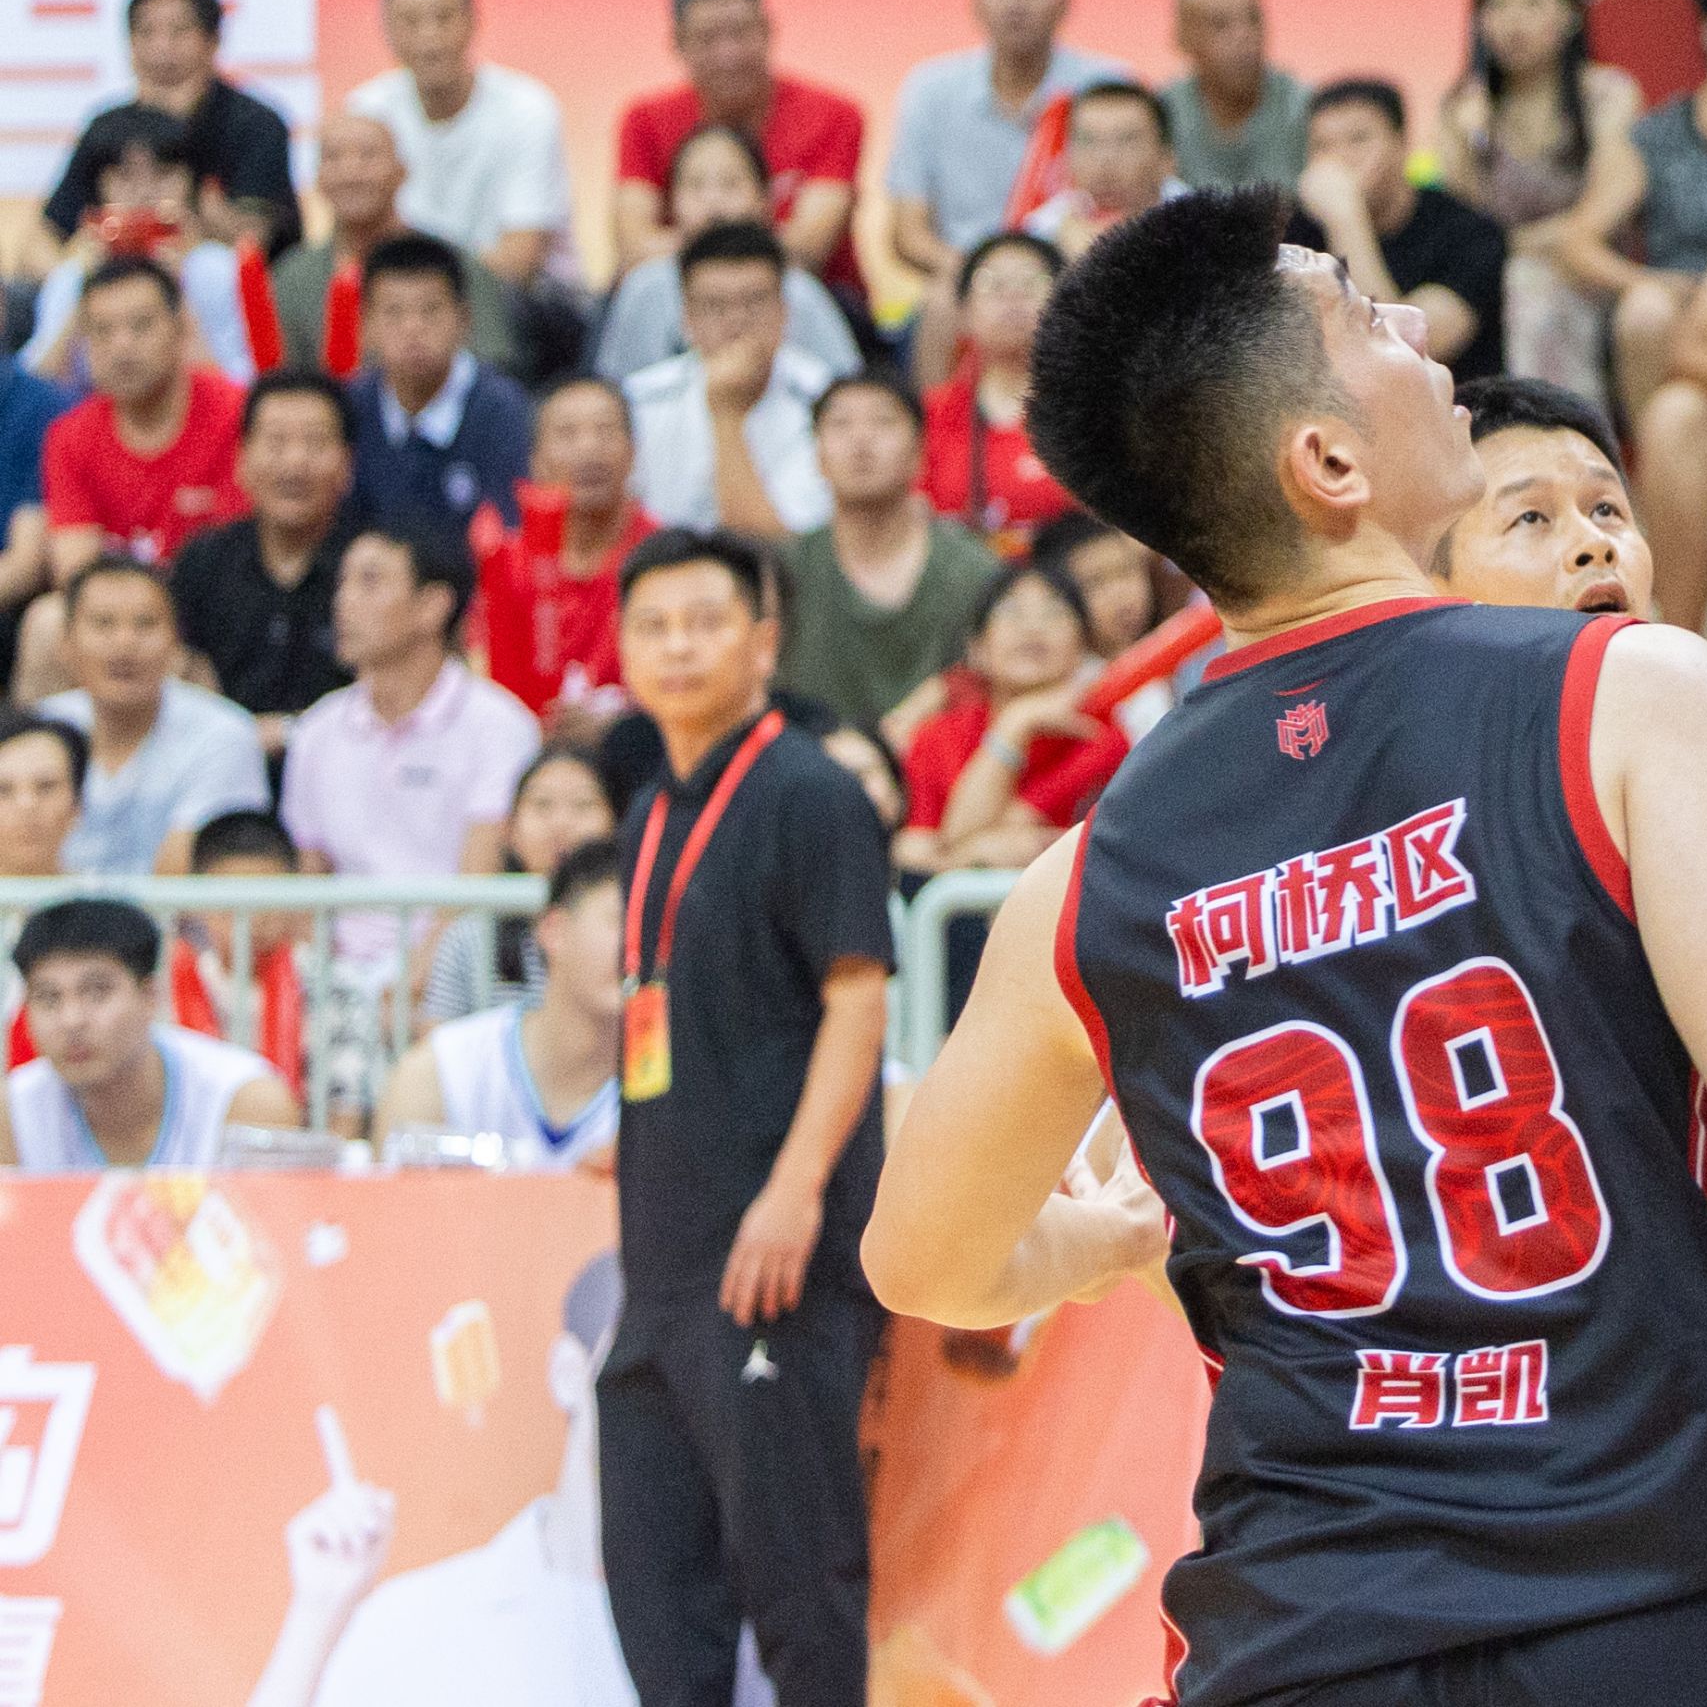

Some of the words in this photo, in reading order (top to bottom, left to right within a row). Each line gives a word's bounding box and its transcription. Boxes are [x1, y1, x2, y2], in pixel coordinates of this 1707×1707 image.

[1164, 797, 1478, 998] 柯桥区
[1191, 955, 1612, 1319] 98
[1349, 1338, 1551, 1431] 肖凯
